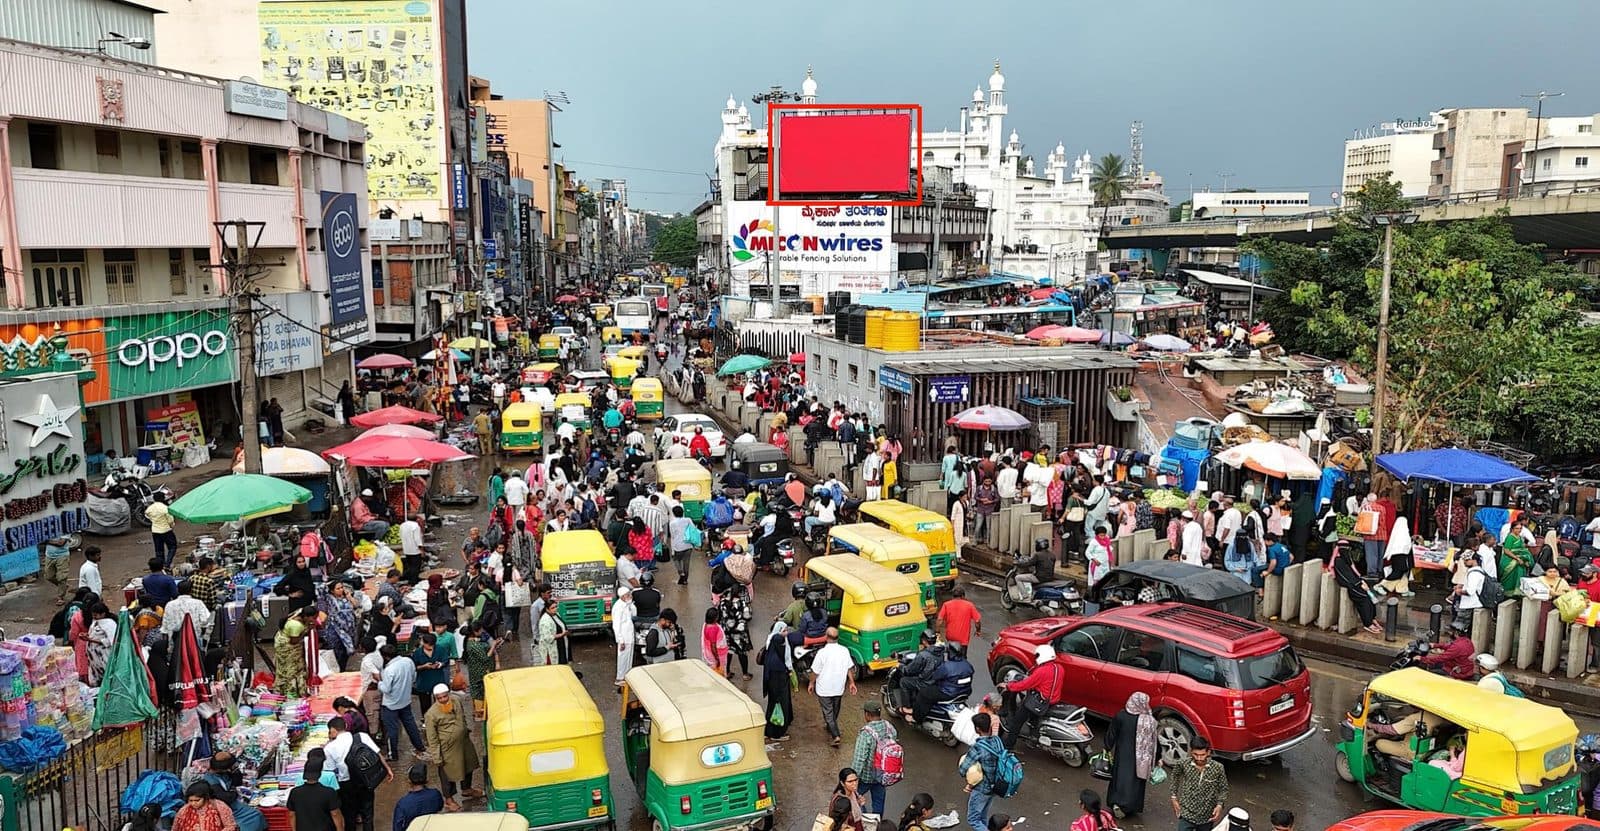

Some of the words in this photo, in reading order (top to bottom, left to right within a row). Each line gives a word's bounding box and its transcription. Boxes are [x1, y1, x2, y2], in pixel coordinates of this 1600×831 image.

[801, 254, 830, 264] Fencing
[833, 254, 867, 262] Solutions
[280, 336, 312, 351] BHAVAN
[118, 330, 227, 372] oppo
[551, 573, 577, 581] THREE
[551, 581, 574, 589] RIDES
[551, 589, 569, 597] FREE
